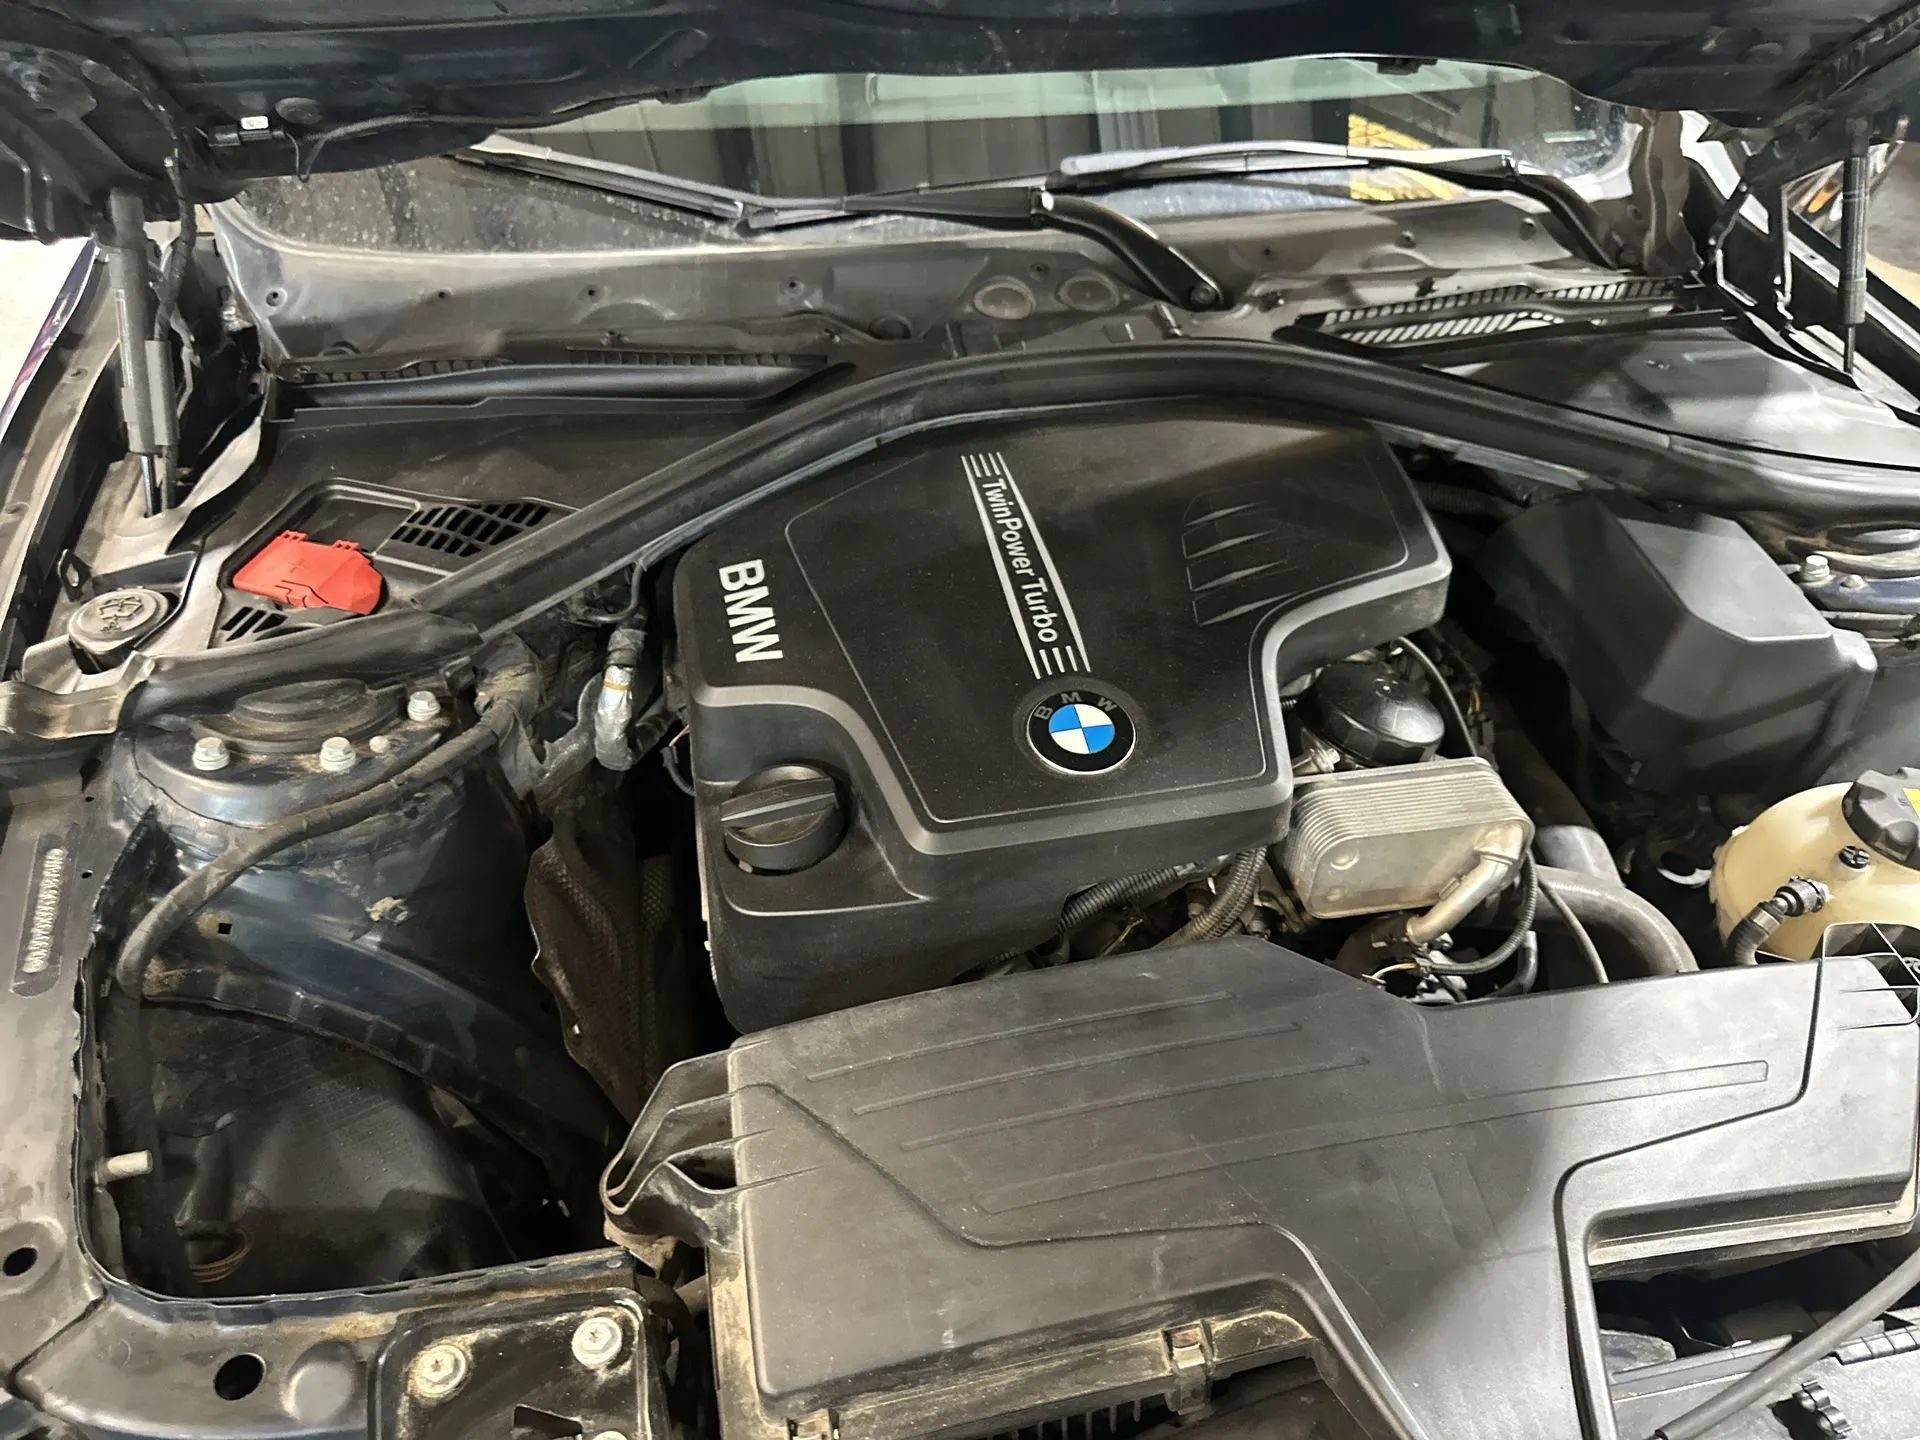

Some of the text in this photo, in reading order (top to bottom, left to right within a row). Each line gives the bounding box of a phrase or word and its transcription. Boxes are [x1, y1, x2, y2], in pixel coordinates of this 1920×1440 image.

[718, 559, 783, 663] BMW
[982, 477, 1058, 643] TwinPower Turbo
[1033, 691, 1117, 720] BMW
